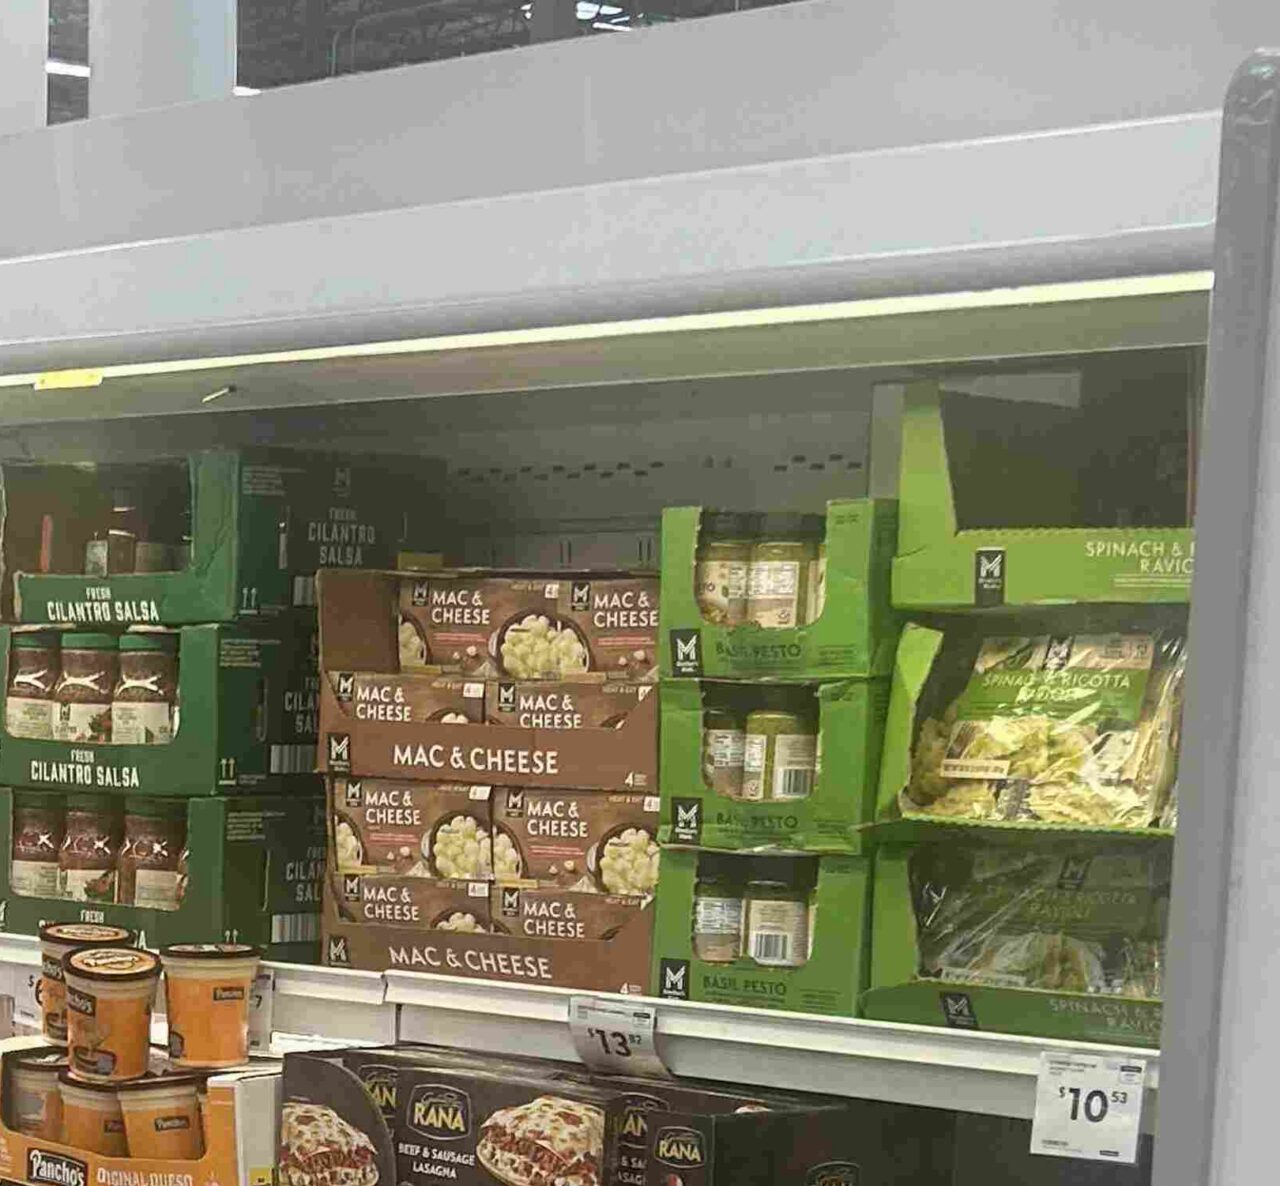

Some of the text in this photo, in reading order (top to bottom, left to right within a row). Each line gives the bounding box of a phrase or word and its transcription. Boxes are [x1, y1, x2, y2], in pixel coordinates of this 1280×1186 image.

[308, 522, 376, 544] CILANTRO
[320, 546, 363, 566] SALSA
[1085, 541, 1171, 559] SPINACH
[86, 588, 112, 601] FRESH
[432, 590, 483, 607] MAC &
[594, 591, 650, 608] MAC &
[47, 601, 159, 622] CILANTRO SALSA
[431, 607, 490, 625] CHEESE
[593, 610, 659, 628] CHEESE
[753, 642, 801, 659] PESTO
[1063, 672, 1131, 689] RICOTTA
[356, 686, 404, 703] MAC &
[519, 693, 573, 711] MAC &
[356, 703, 412, 721] CHEESE
[519, 712, 582, 729] CHEESE
[70, 749, 95, 764] FRESH
[393, 744, 559, 774] MAC & CHEESE
[31, 765, 140, 789] CILANTRO SALSA
[365, 790, 413, 807] MAC &
[365, 808, 420, 826] CHEESE
[527, 800, 579, 818] MAC &
[527, 819, 588, 838] CHEESE
[752, 812, 799, 829] PESTO
[363, 886, 411, 903] MAC &
[363, 903, 419, 922] CHEESE
[523, 901, 575, 919] MAC &
[523, 920, 585, 938] CHEESE
[389, 946, 553, 980] MAC & CHEESE
[703, 975, 787, 996] BASIL PESTO
[413, 1103, 466, 1133] RANA
[398, 1143, 475, 1167] BEEF & SAUSAGE
[659, 1138, 702, 1164] RANA
[412, 1162, 457, 1180] LASAGNA
